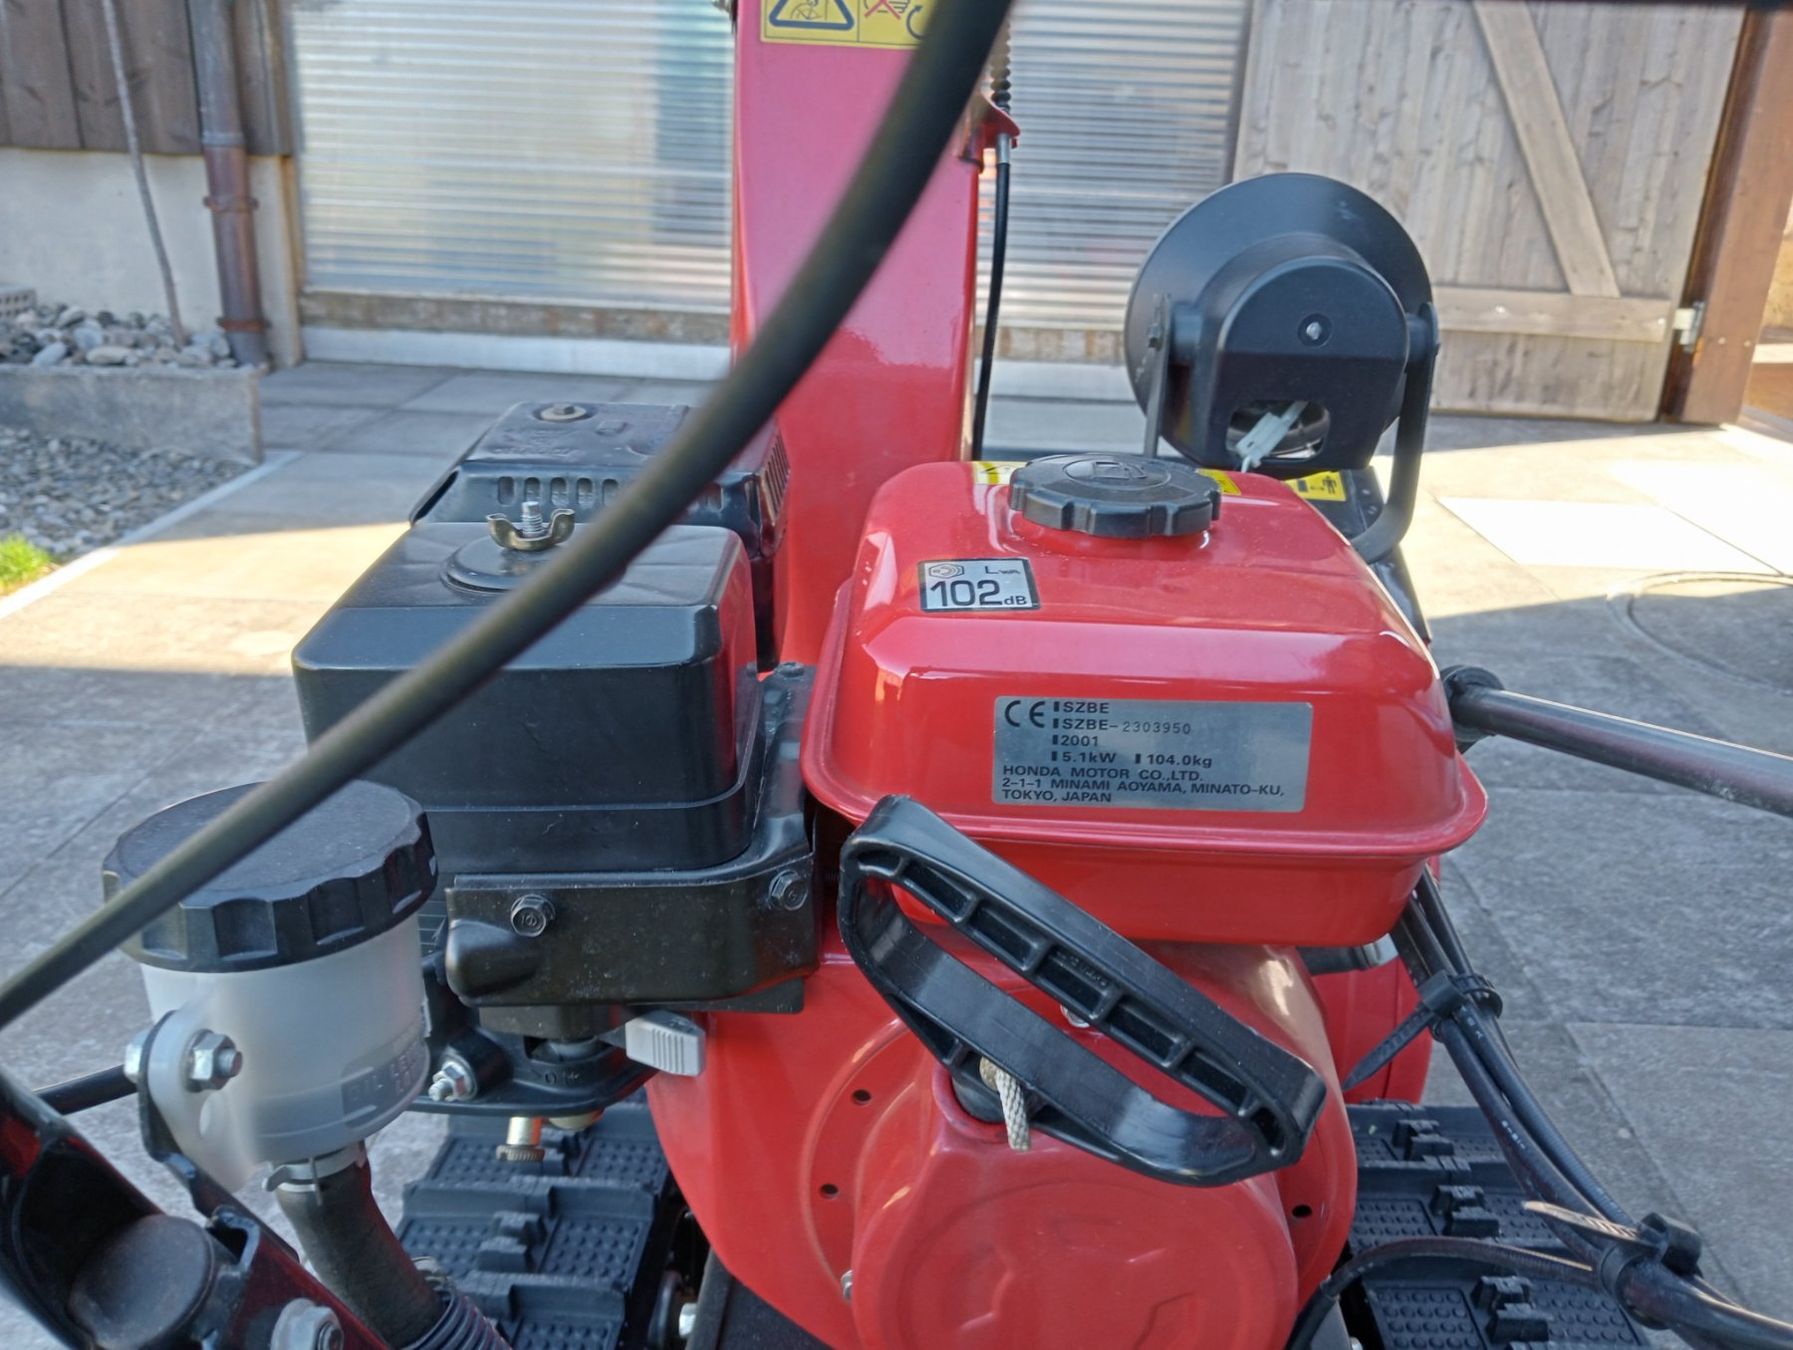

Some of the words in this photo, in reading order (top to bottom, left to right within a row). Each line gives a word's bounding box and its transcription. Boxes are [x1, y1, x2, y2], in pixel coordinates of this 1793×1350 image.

[930, 580, 1002, 607] 102
[1004, 595, 1028, 605] dB
[1063, 702, 1109, 714] SZBE
[1062, 718, 1191, 735] SZBE-2303950
[1060, 735, 1099, 747] 2001
[1062, 752, 1117, 763] 5.1kW
[1146, 754, 1212, 768] 104.0kg
[1003, 765, 1061, 777] HONDA
[1070, 767, 1130, 779] MOTOR
[1138, 769, 1203, 781] CO.,LTD.
[1001, 788, 1058, 802] TOKYO,
[1061, 791, 1112, 802] JAPAN
[1002, 777, 1042, 788] 2-1-1
[1050, 779, 1110, 790] MINAMI
[1116, 781, 1186, 794] AOYAMA,
[1191, 783, 1285, 797] MINATO-KU,
